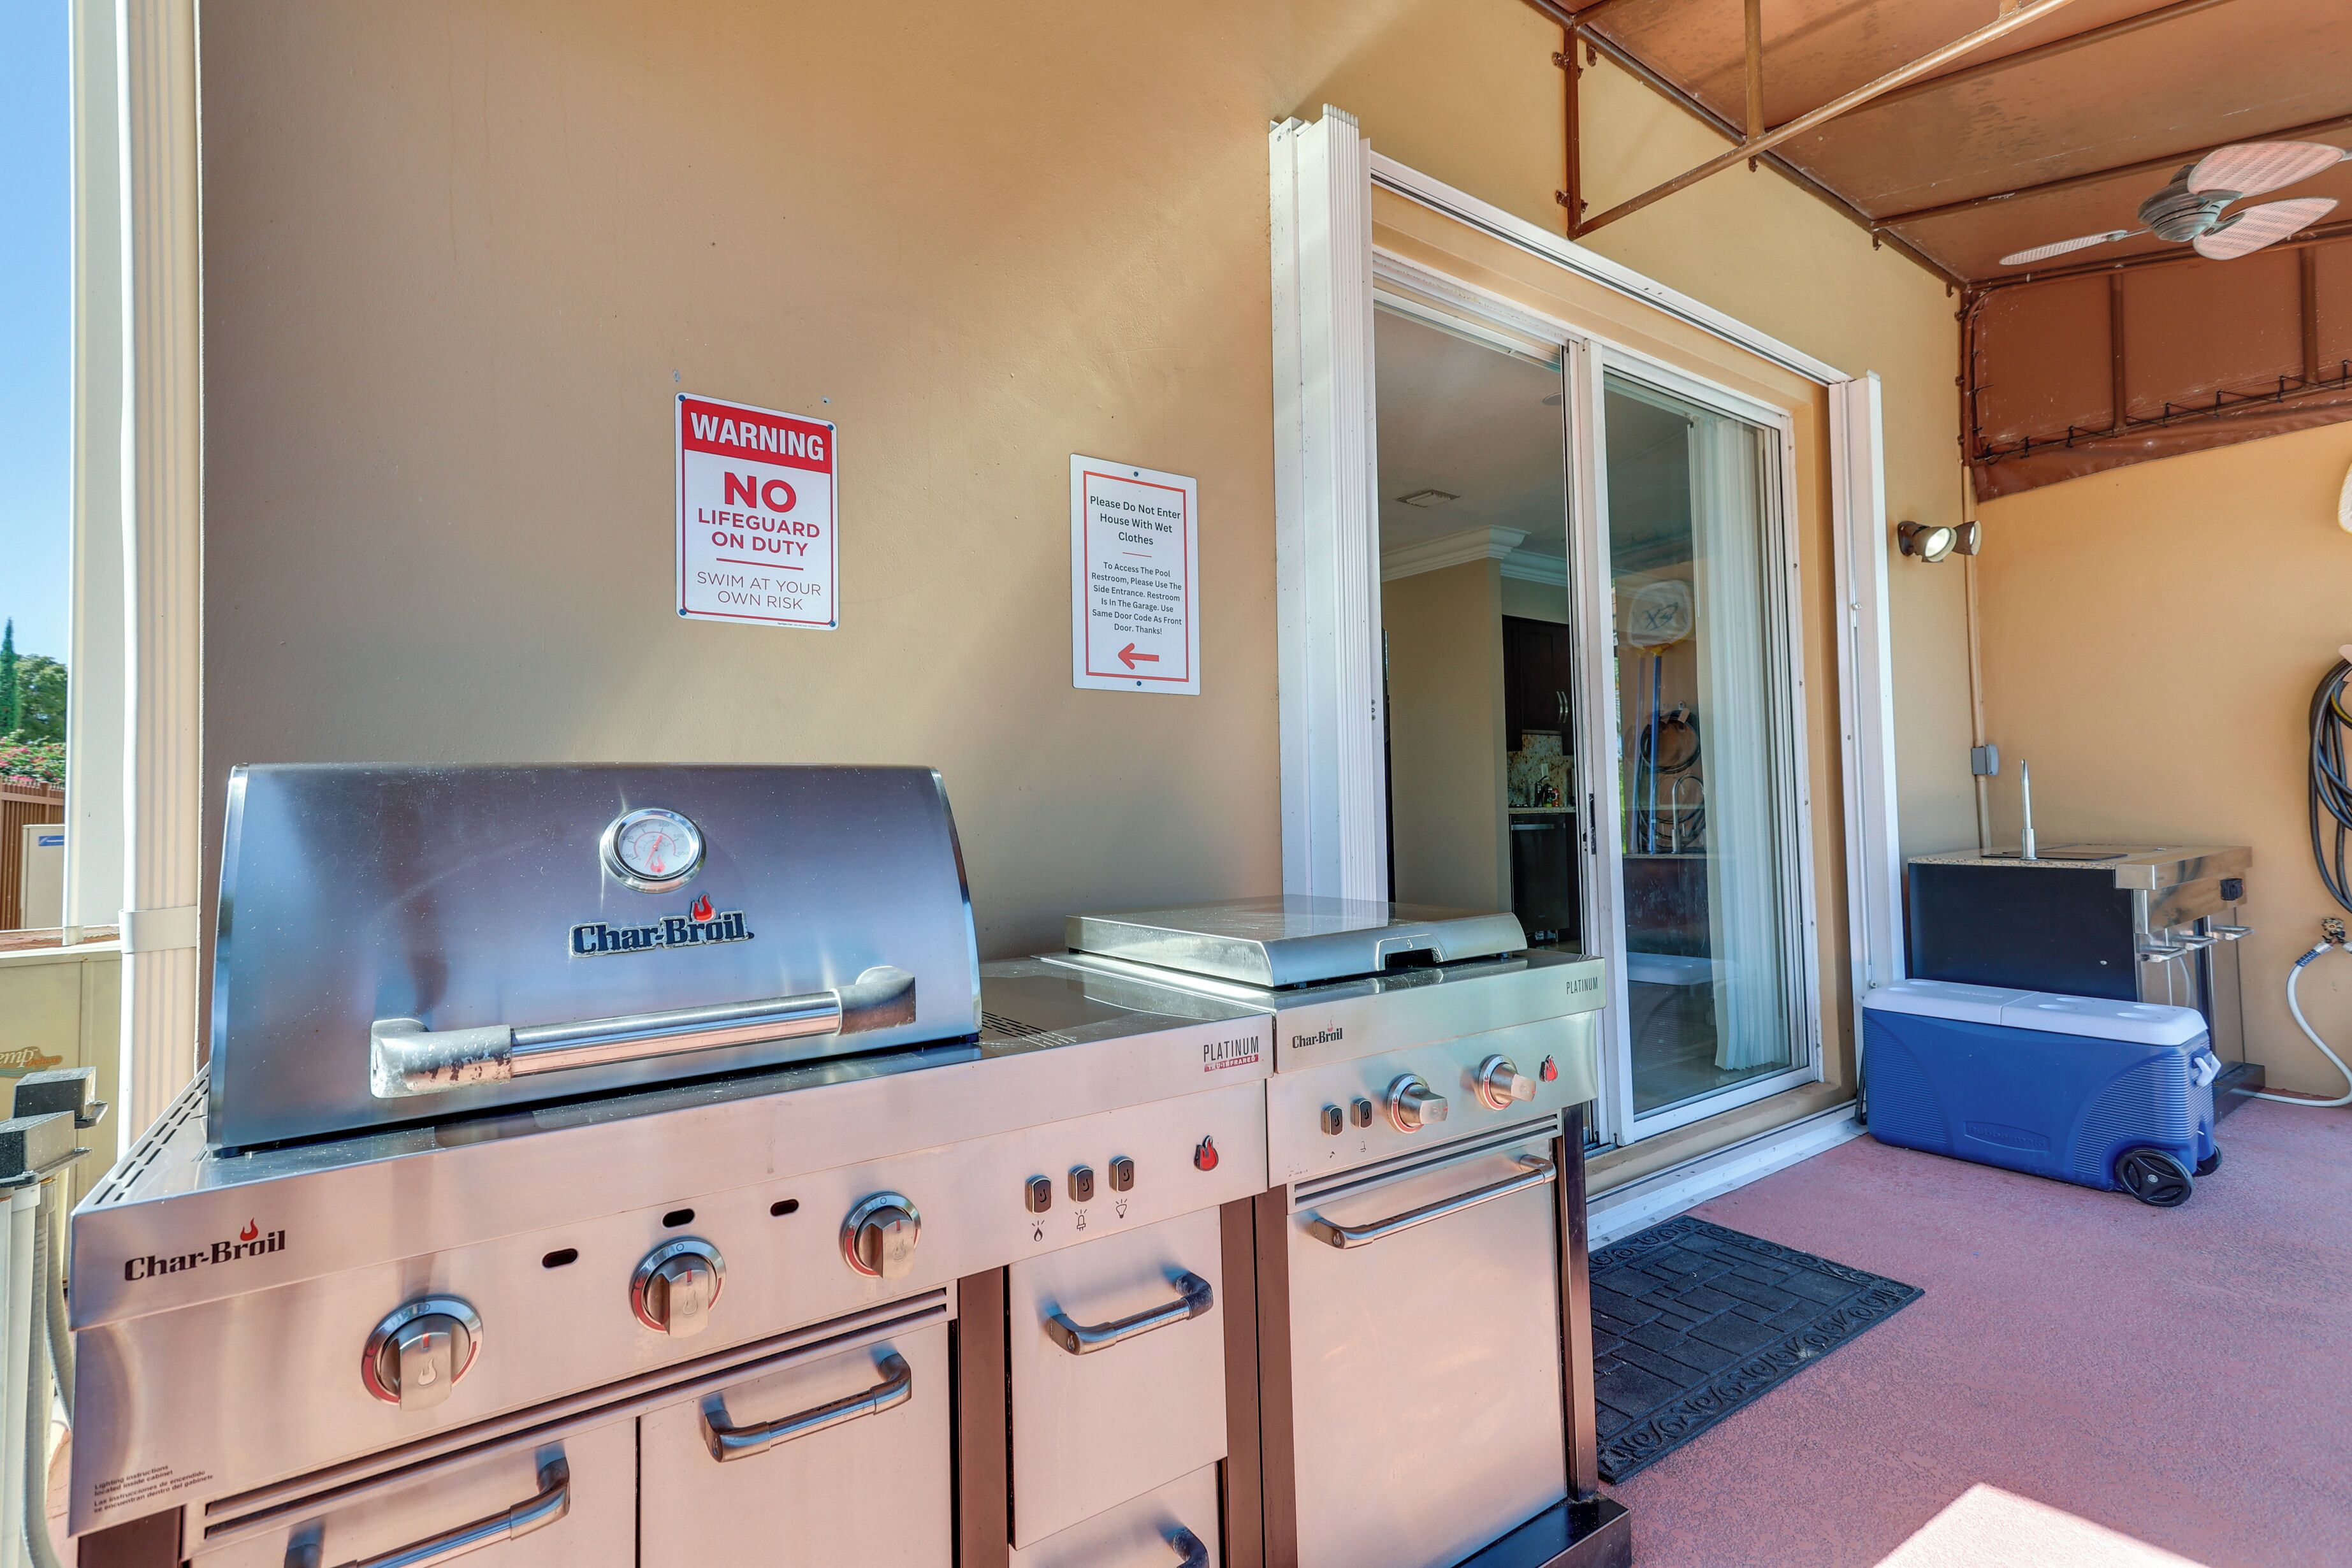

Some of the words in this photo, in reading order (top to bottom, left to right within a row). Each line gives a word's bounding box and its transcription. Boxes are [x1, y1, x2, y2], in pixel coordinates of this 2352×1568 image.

[690, 412, 824, 461] WARNING
[724, 472, 796, 512] NO
[1090, 496, 1121, 509] Please
[1123, 502, 1136, 511] Do
[1138, 504, 1155, 515] Not
[1158, 507, 1180, 519] Enter
[699, 508, 820, 538] LIFEGUARD
[1100, 514, 1129, 526] House
[1132, 518, 1152, 530] With
[1155, 522, 1172, 533] Wet
[711, 531, 743, 549] ON
[753, 536, 808, 556] DUTY
[1119, 532, 1153, 545] Clothes
[1091, 572, 1129, 585] Restroom,
[1130, 577, 1153, 587] Please
[1169, 582, 1182, 590] The
[1103, 562, 1112, 570] To
[1114, 563, 1139, 573] Access
[1140, 567, 1153, 575] The
[1155, 569, 1170, 577] Pool
[697, 571, 743, 588] SWIM
[750, 577, 770, 590] AT
[776, 580, 821, 595] YOUR
[1093, 585, 1110, 593] Side
[1111, 588, 1145, 598] Entrance.
[1147, 592, 1180, 602] Restroom
[718, 591, 760, 606] OWN
[767, 595, 803, 610] RISK
[1118, 600, 1131, 608] The
[1133, 602, 1159, 613] Garage.
[1161, 604, 1173, 613] Use
[1092, 609, 1112, 618] Same
[1114, 611, 1132, 620] Door
[1133, 613, 1151, 622] Code
[1163, 616, 1182, 625] Front
[1114, 623, 1133, 632] Door.
[1135, 626, 1162, 634] Thanks!
[573, 913, 746, 954] Char-Broil
[1566, 976, 1598, 995] PLATINUM
[1203, 1036, 1259, 1063] PLATINUM
[1291, 1027, 1343, 1049] Char-Broil
[124, 1230, 286, 1281] Char-Broil
[94, 1485, 121, 1496] located
[124, 1479, 145, 1488] inside
[147, 1470, 173, 1481] cabinet
[95, 1477, 124, 1490] Lighting
[126, 1465, 168, 1480] instructions
[109, 1485, 157, 1502] instrucciones
[170, 1470, 205, 1485] encendido
[105, 1495, 145, 1510] encuentran
[147, 1487, 170, 1497] dentro
